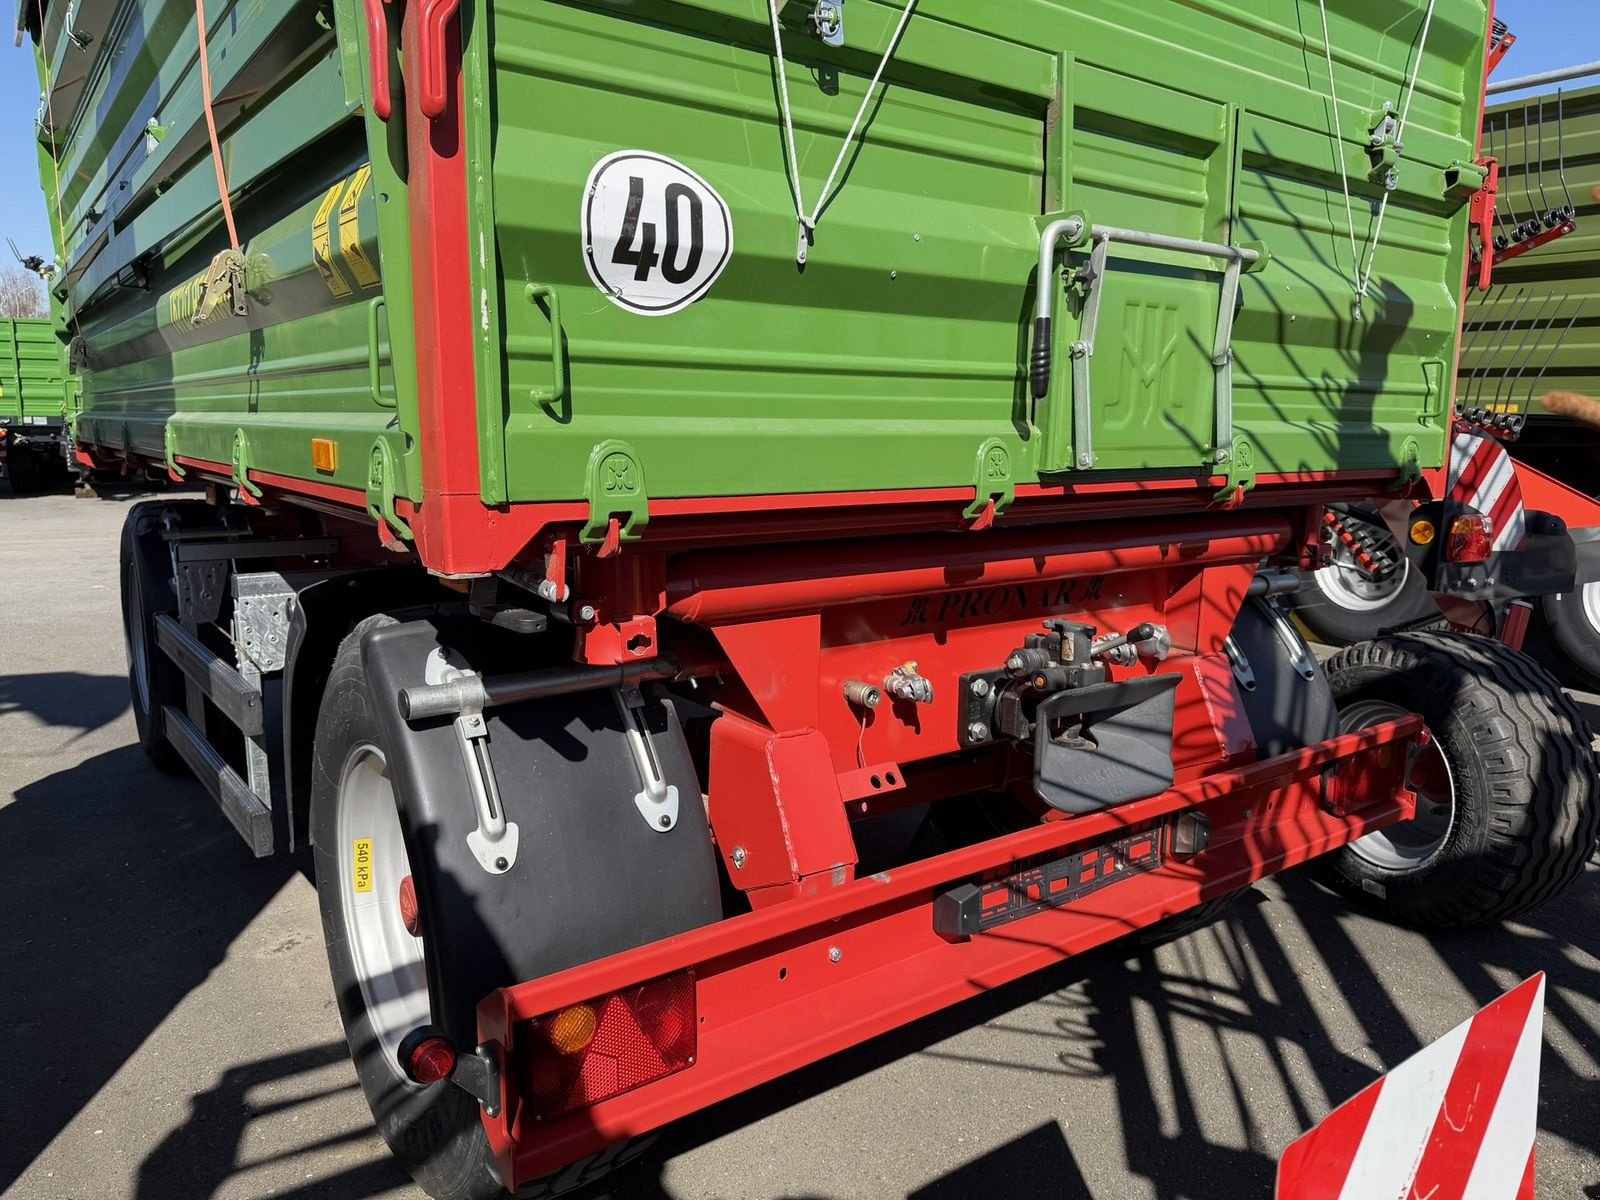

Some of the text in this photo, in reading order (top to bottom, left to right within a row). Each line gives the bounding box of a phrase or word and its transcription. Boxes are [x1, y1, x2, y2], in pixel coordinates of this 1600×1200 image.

[611, 176, 704, 285] 40
[937, 578, 1077, 622] PRONAR
[357, 843, 369, 888] 540 kPa
